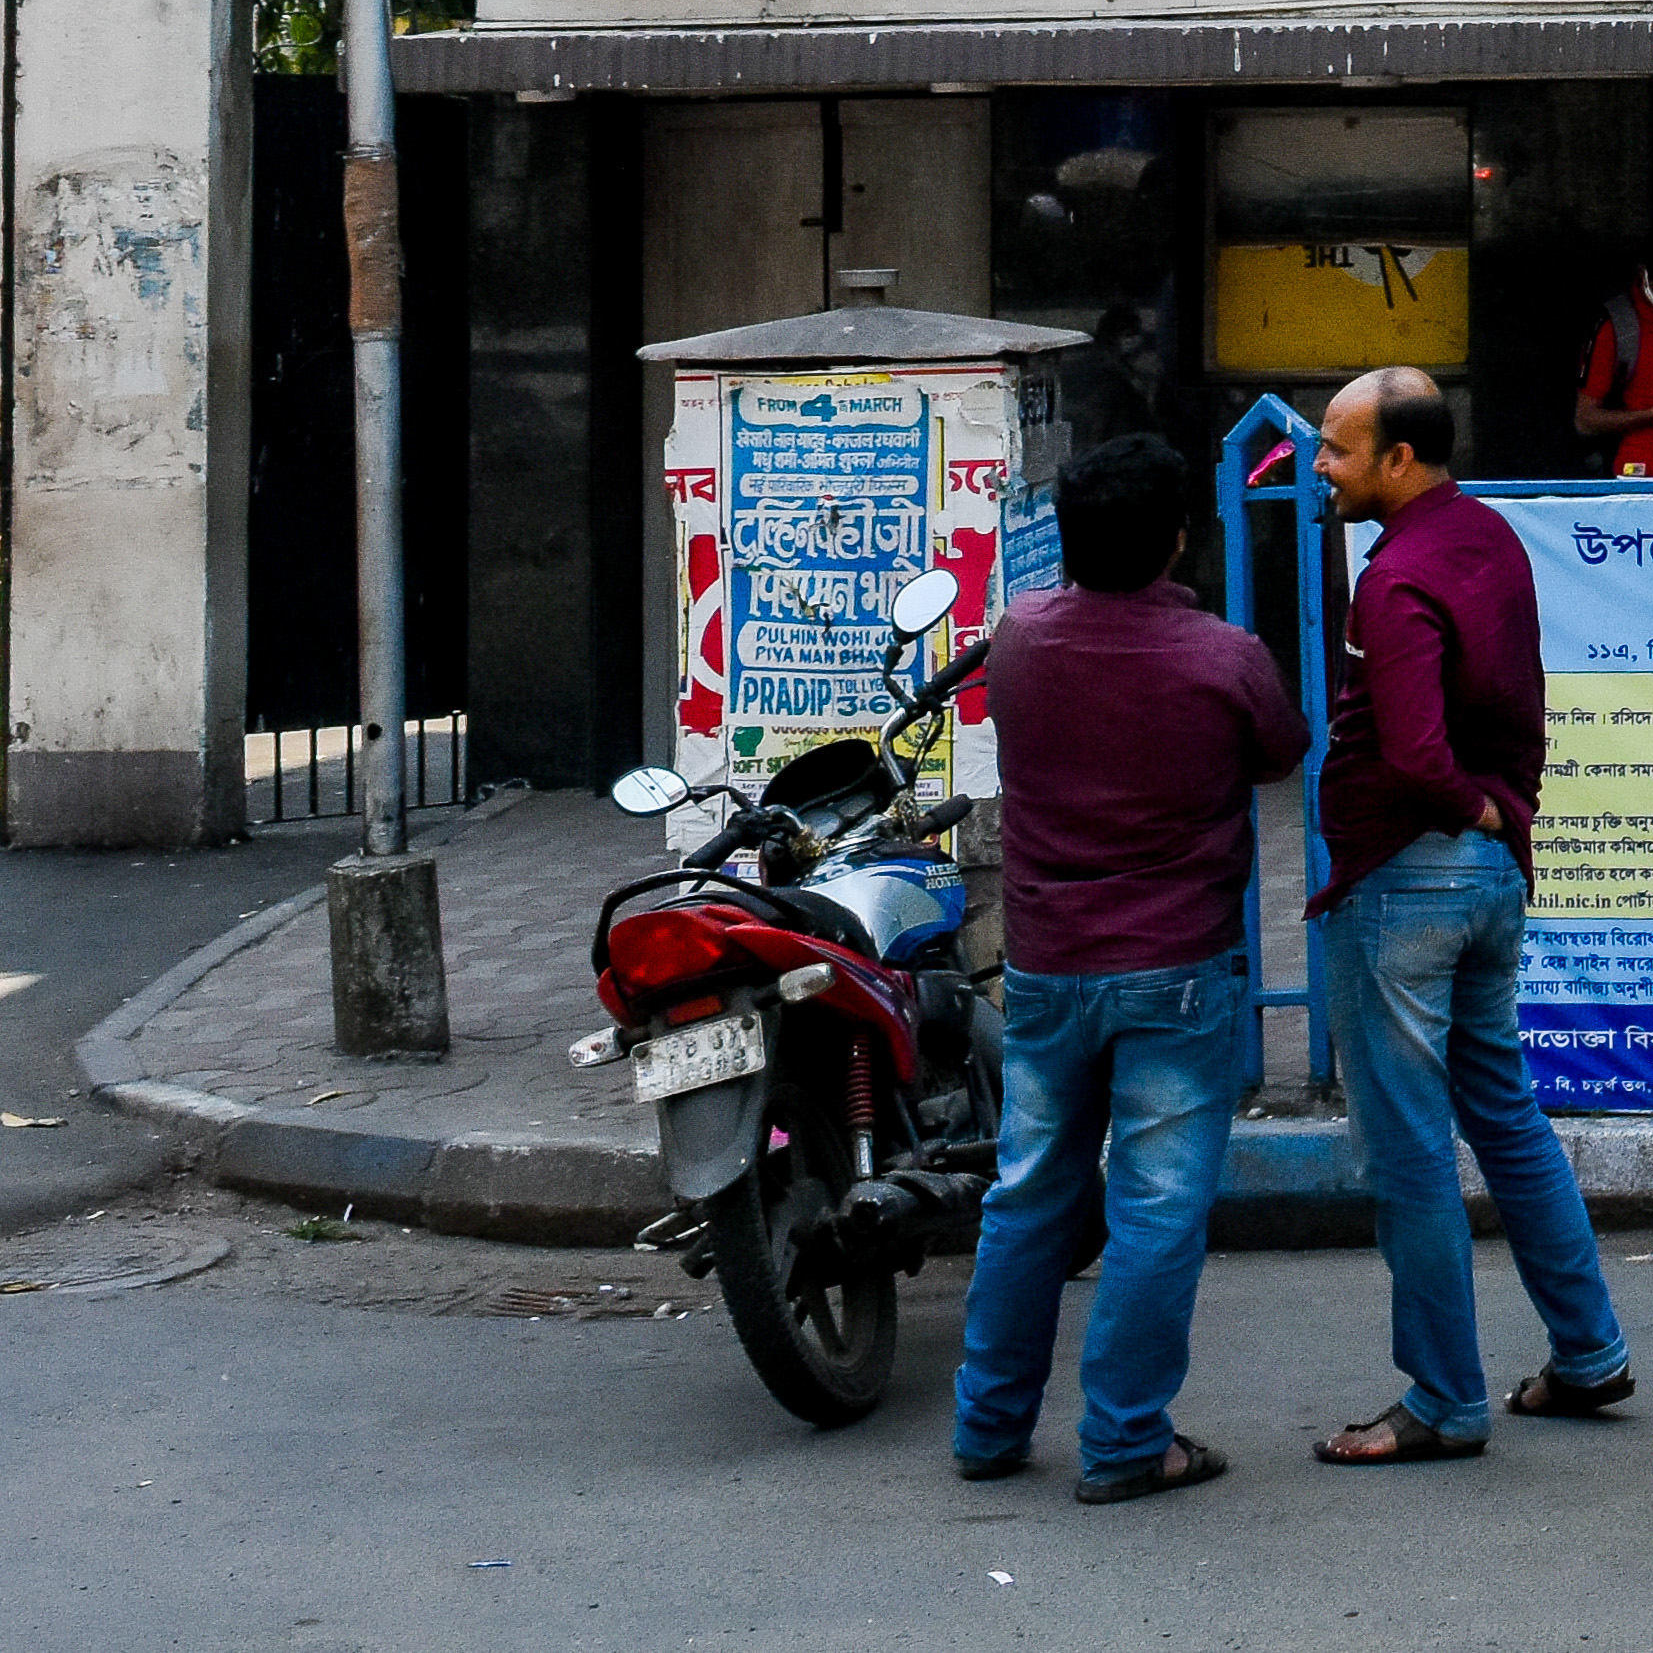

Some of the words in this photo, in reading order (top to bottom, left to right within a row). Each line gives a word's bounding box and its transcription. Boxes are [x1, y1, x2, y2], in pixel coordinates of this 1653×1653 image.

[757, 397, 797, 412] FROM
[849, 397, 902, 412] MARCH
[756, 627, 818, 645] DULHIN
[823, 630, 870, 646] WOHI
[756, 646, 794, 662] PIYA
[800, 648, 835, 665] MAN
[743, 677, 832, 716] PRADIP
